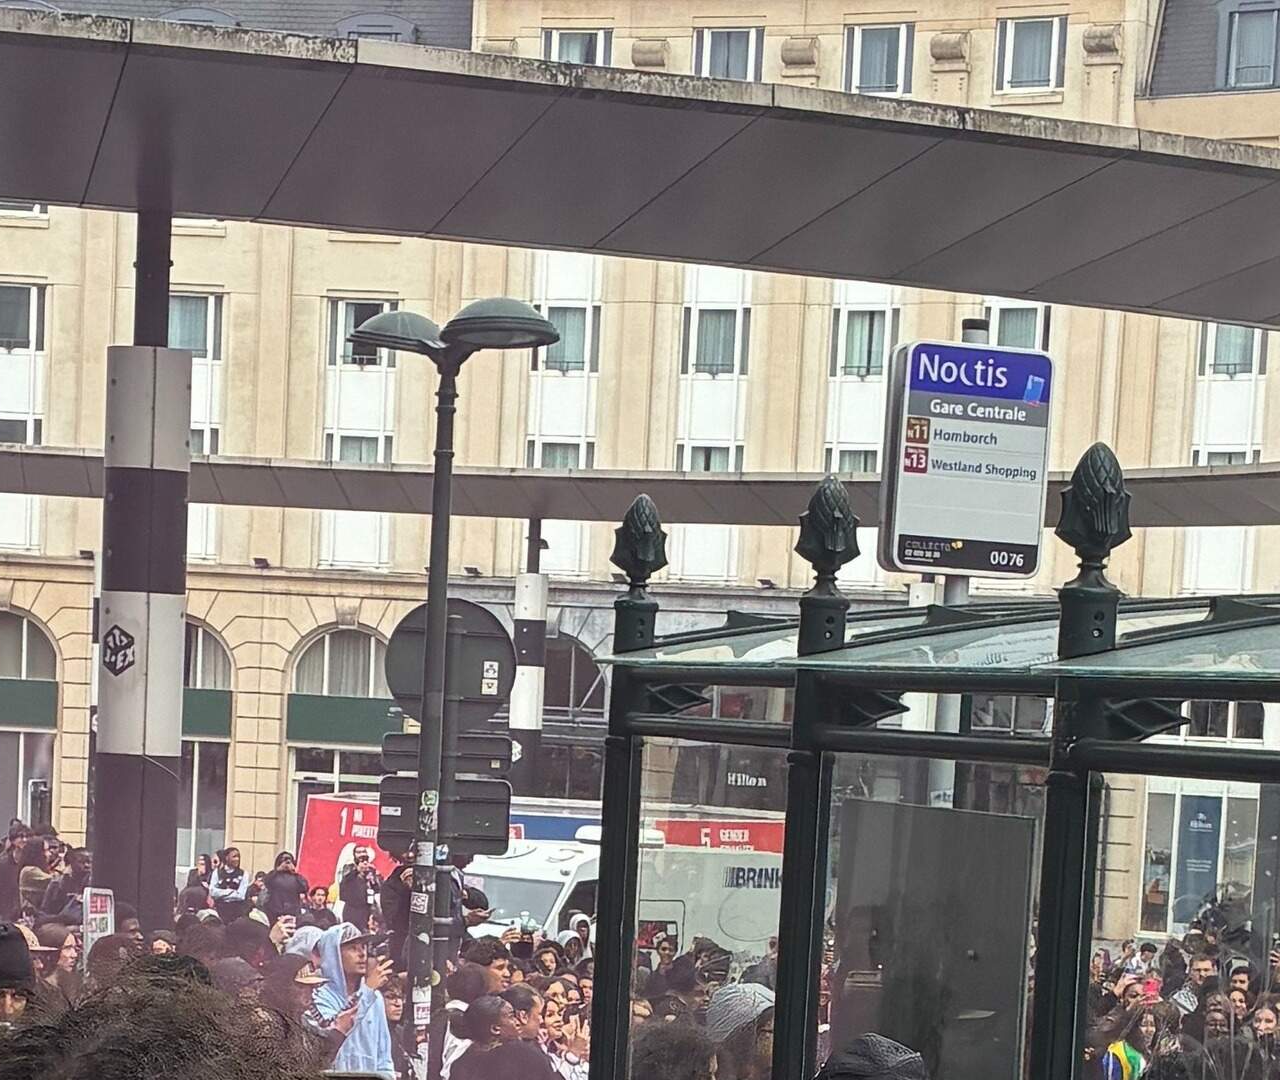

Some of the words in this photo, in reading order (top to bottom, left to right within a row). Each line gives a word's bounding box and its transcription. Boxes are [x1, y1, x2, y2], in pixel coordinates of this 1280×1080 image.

[918, 352, 1009, 388] Noctis
[930, 399, 964, 416] Gare
[967, 402, 1027, 422] Centrale
[933, 428, 998, 446] Homborch
[931, 458, 982, 474] Westland
[985, 462, 1037, 481] Shopping
[989, 550, 1024, 567] 0076
[340, 806, 349, 837] 1
